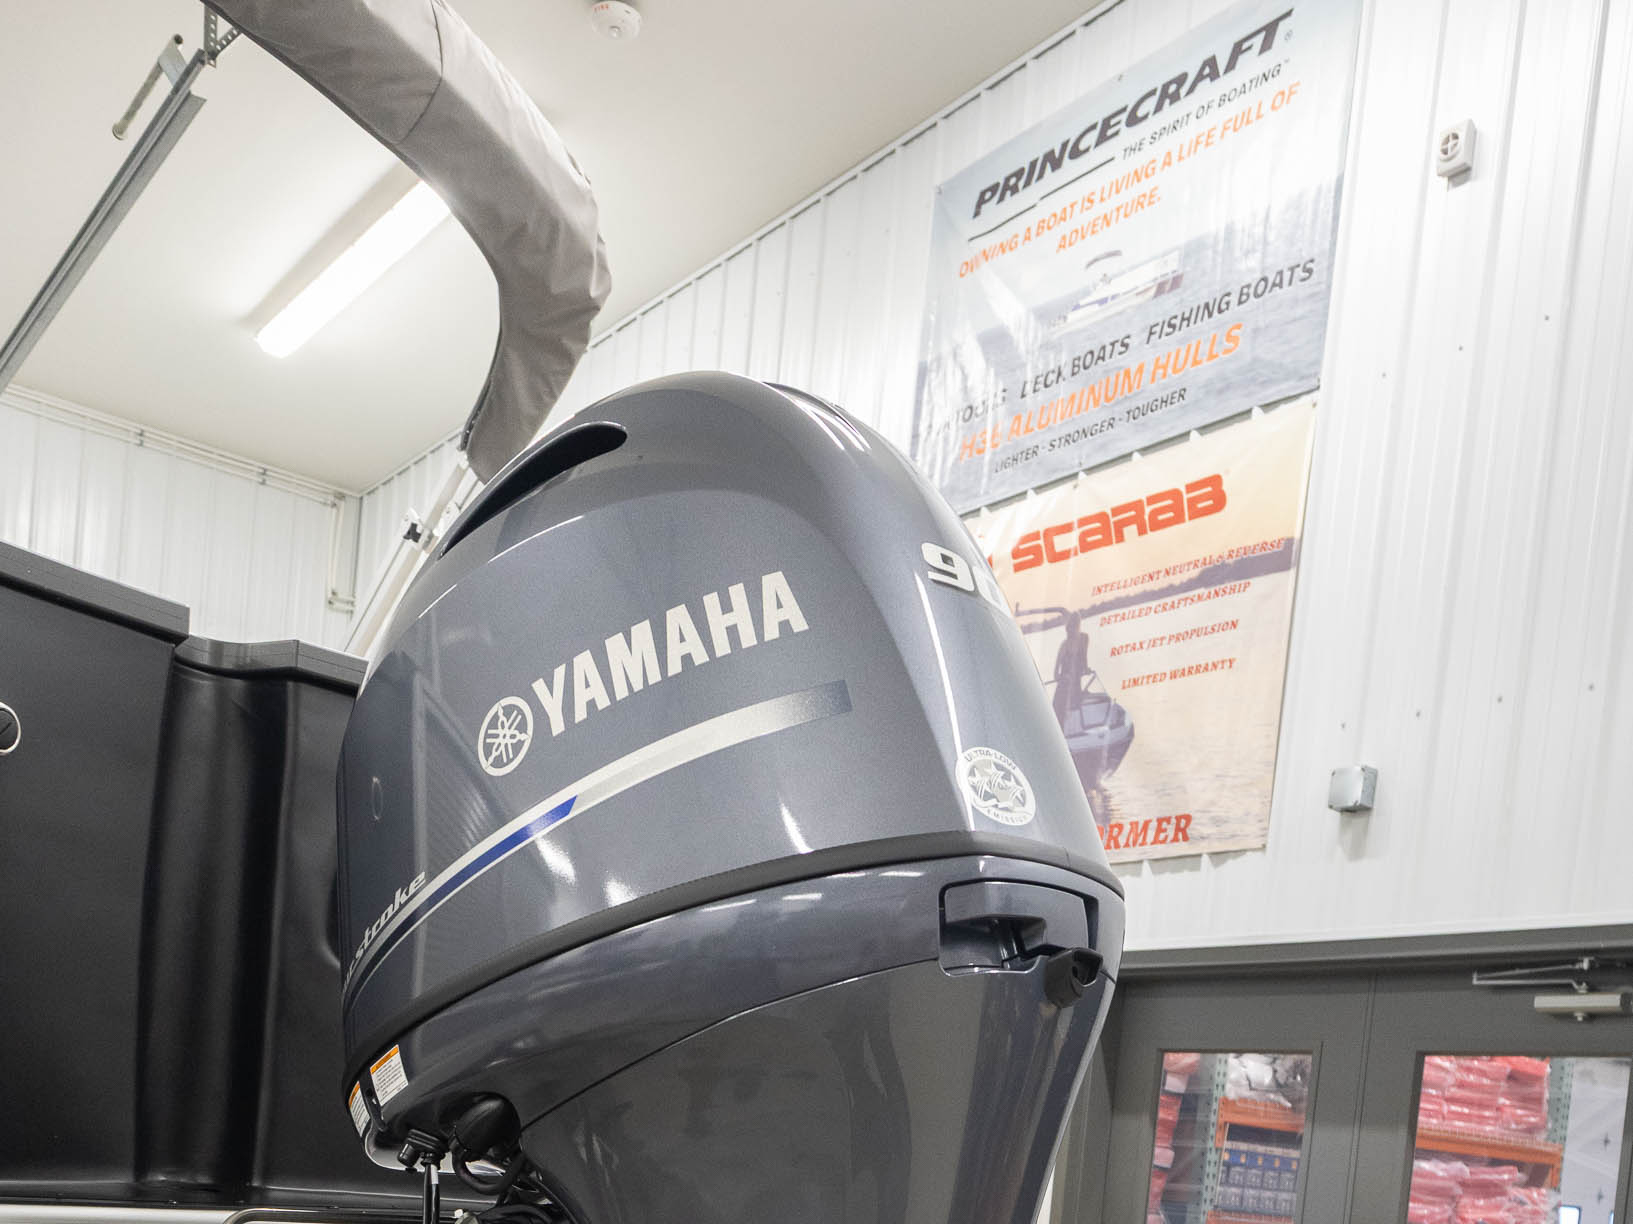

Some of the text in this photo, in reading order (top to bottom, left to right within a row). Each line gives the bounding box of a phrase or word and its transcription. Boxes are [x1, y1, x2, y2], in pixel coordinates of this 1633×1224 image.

[973, 9, 1293, 219] PRINCECRAFT
[1122, 62, 1282, 160] THE SPIRIT OF BOATING
[959, 81, 1301, 278] OWNING A BOAT IS LIVING A LIFE FULL OF
[1055, 186, 1161, 253] ADVENTURE.
[1072, 333, 1130, 375] BOATS
[1146, 292, 1233, 345] FISHING
[1237, 258, 1315, 307] BOATS
[995, 386, 1188, 473] LIGHTER STRONGER TOUGHER
[1007, 359, 1145, 439] ALUMINUM
[1150, 323, 1244, 387] HULLS
[1010, 473, 1228, 573] SCARAB
[1091, 570, 1163, 597] INTELLIGENT
[1163, 555, 1215, 577] NEUTRAL
[1225, 537, 1285, 560] REVERSE
[1099, 581, 1251, 627] DETAILED CRAFTSMANSHIP
[1110, 619, 1240, 657] ROTAX JET PROPULSION
[531, 570, 810, 739] YAMAHA
[1120, 658, 1237, 690] LIMITED WARRANTY
